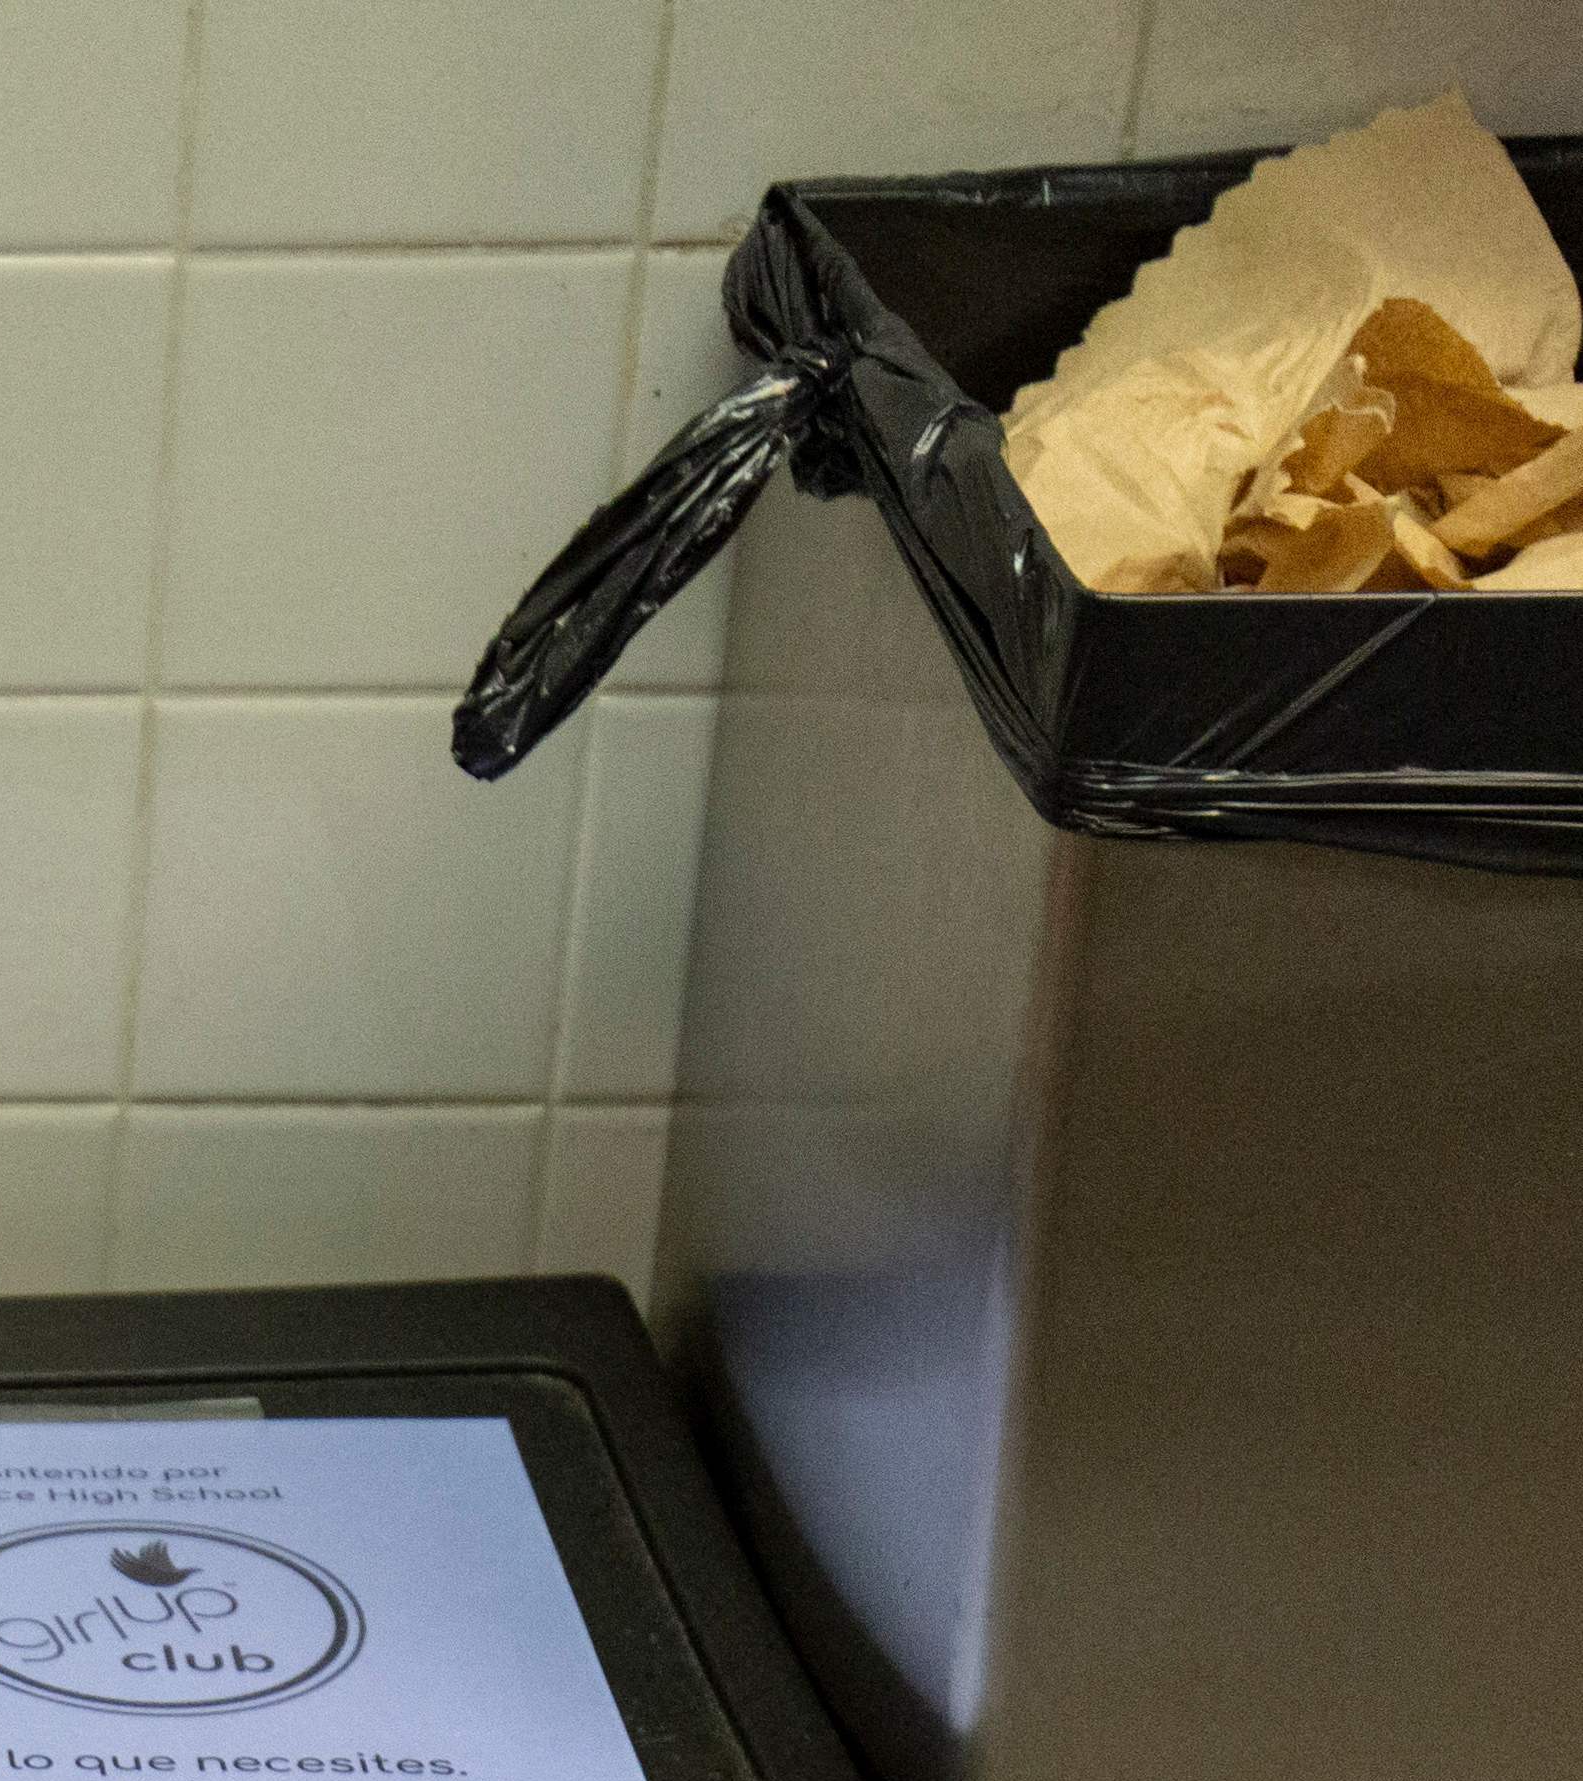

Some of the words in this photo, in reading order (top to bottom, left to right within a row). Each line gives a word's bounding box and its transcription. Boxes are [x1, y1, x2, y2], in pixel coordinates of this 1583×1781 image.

[162, 1465, 228, 1482] por
[48, 1487, 139, 1506] High
[151, 1485, 283, 1502] School
[121, 1645, 276, 1674] club
[7, 1749, 54, 1771] lo
[74, 1754, 176, 1777] que
[196, 1752, 468, 1777] necesites.
